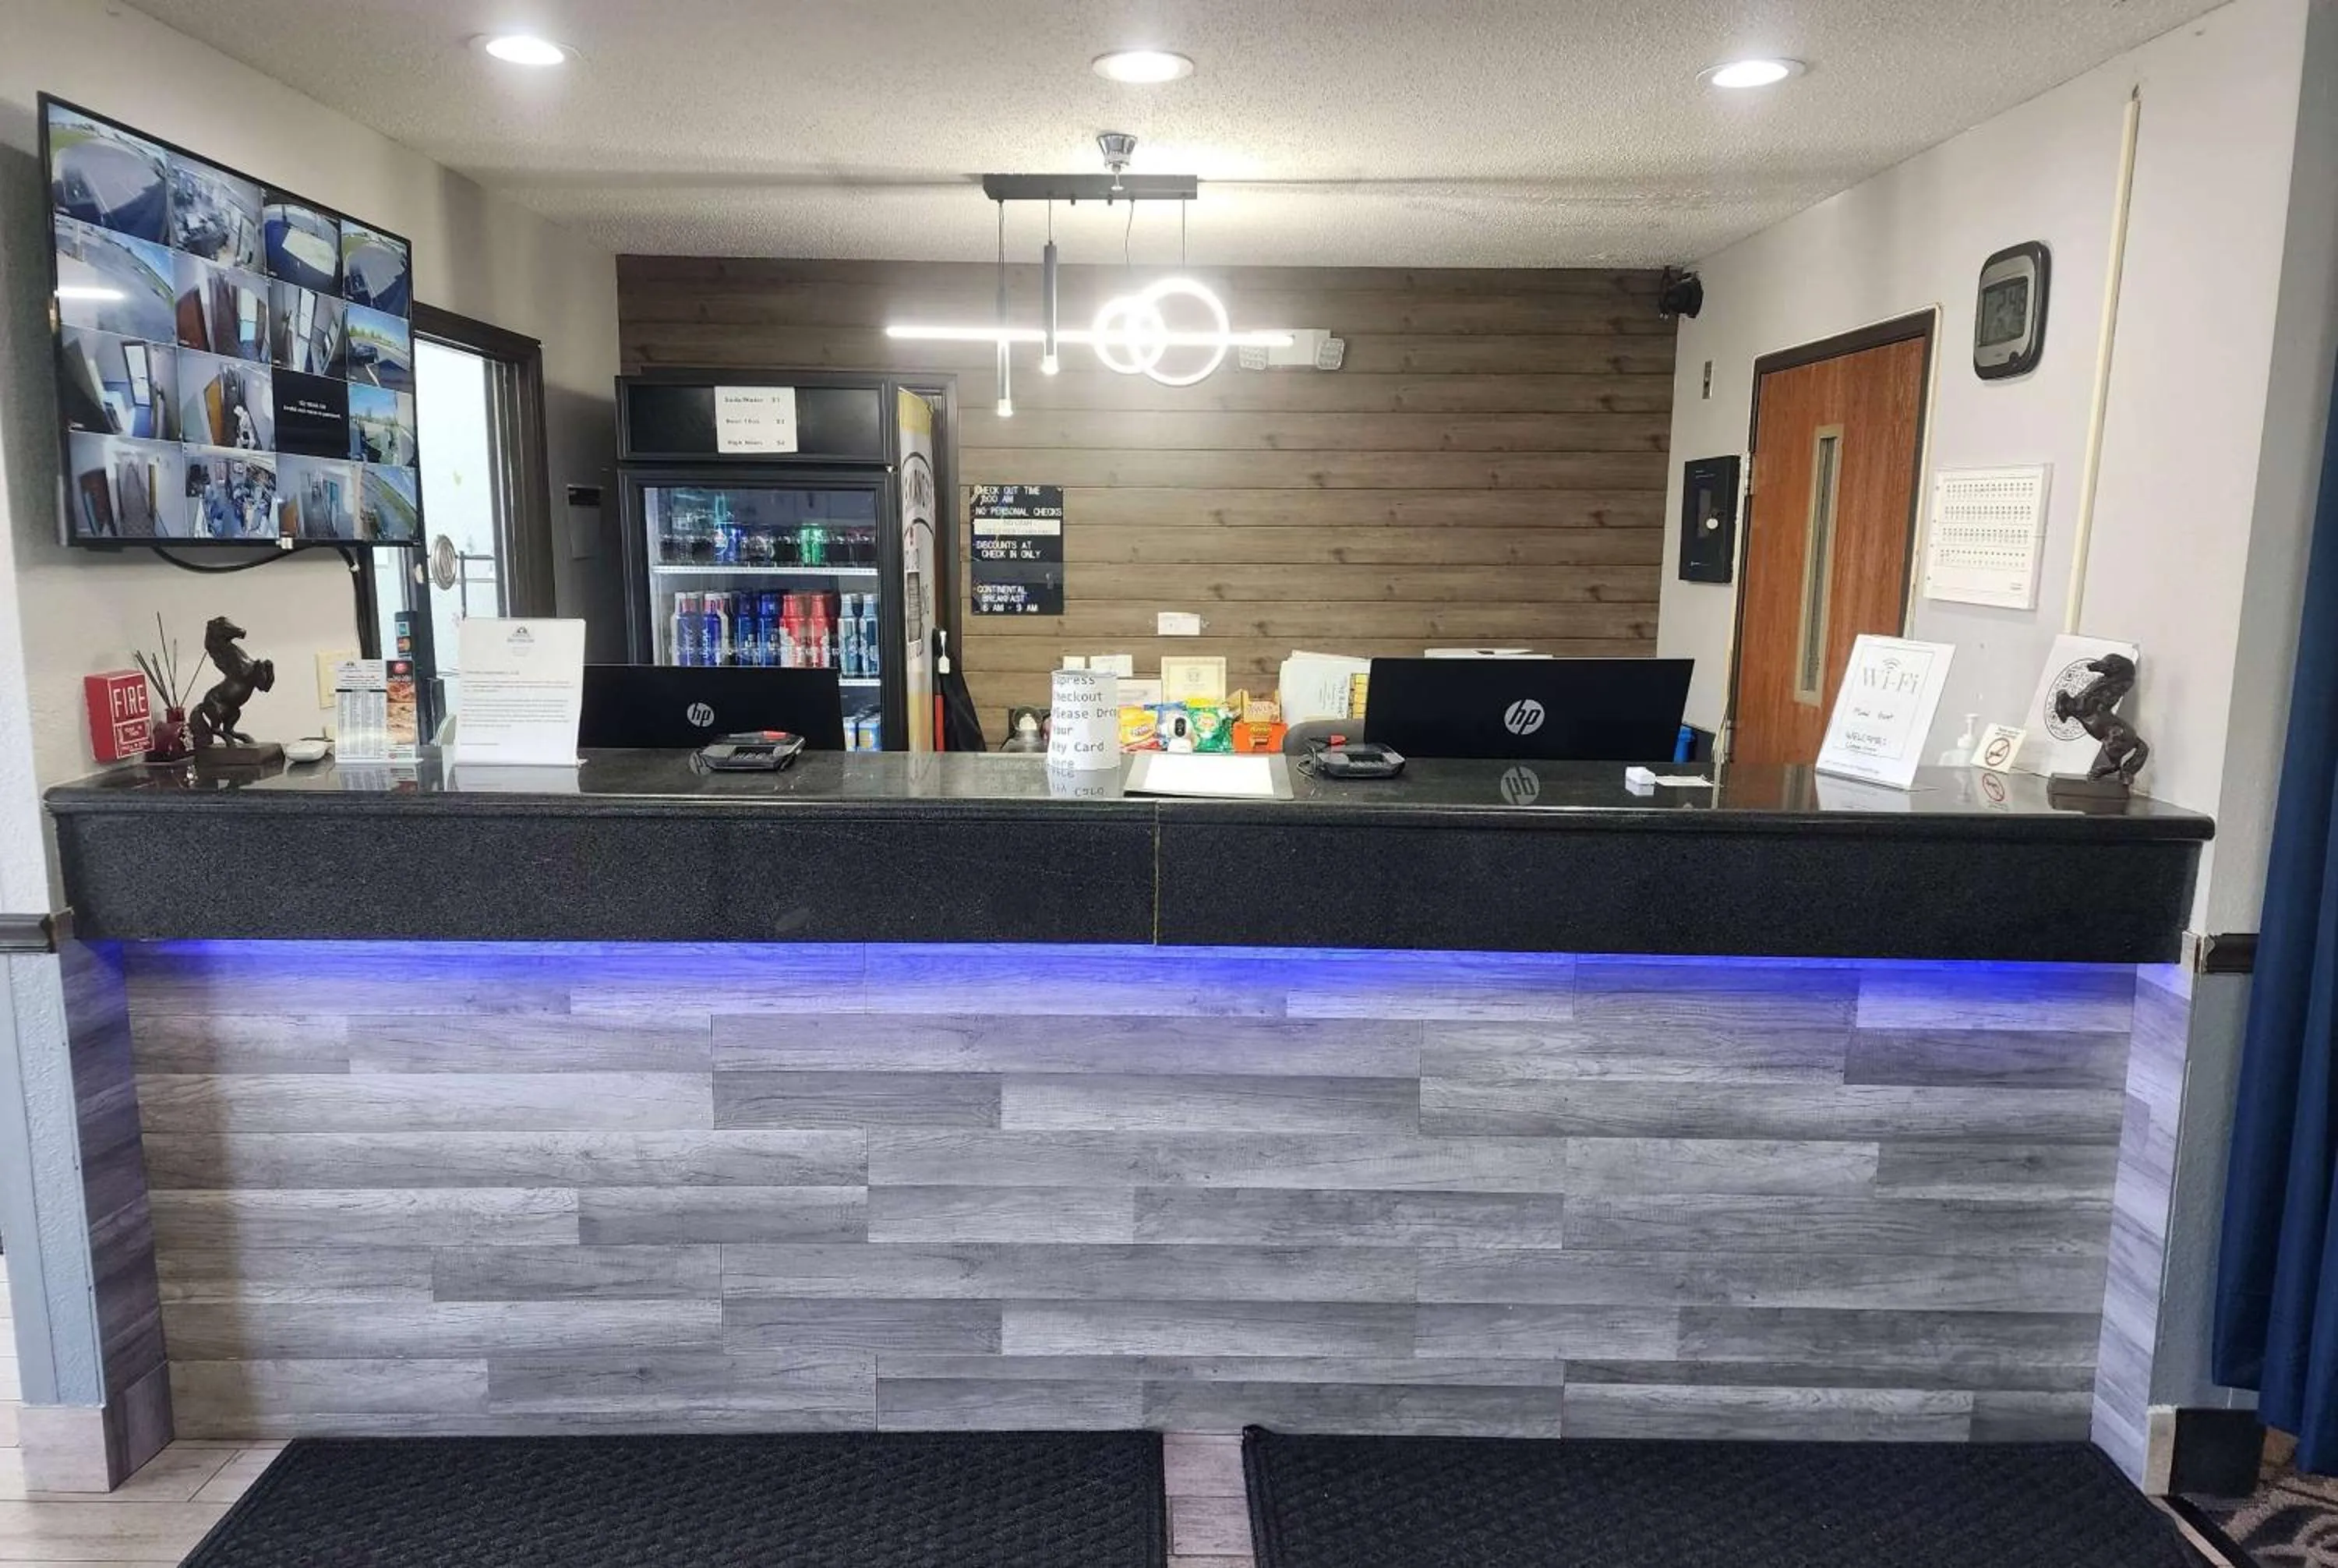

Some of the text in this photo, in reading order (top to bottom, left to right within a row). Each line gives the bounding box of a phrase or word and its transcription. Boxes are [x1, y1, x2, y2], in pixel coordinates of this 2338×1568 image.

[975, 486, 1040, 496] CHECK OUT TIME
[1033, 507, 1062, 517] CHECKS
[976, 541, 1032, 549] DISCOUNTS AT
[982, 550, 1041, 559] CHECK IN ONLY
[977, 585, 1027, 595] CONTINENTAL
[982, 595, 1025, 603] BREAKFAST
[992, 603, 1005, 612] AM
[1026, 603, 1038, 612] AM
[1863, 667, 1919, 693] Wi-Fi
[113, 684, 147, 717] FIRE
[687, 702, 715, 727] hp
[1504, 699, 1545, 734] hp
[1074, 742, 1104, 752] Card
